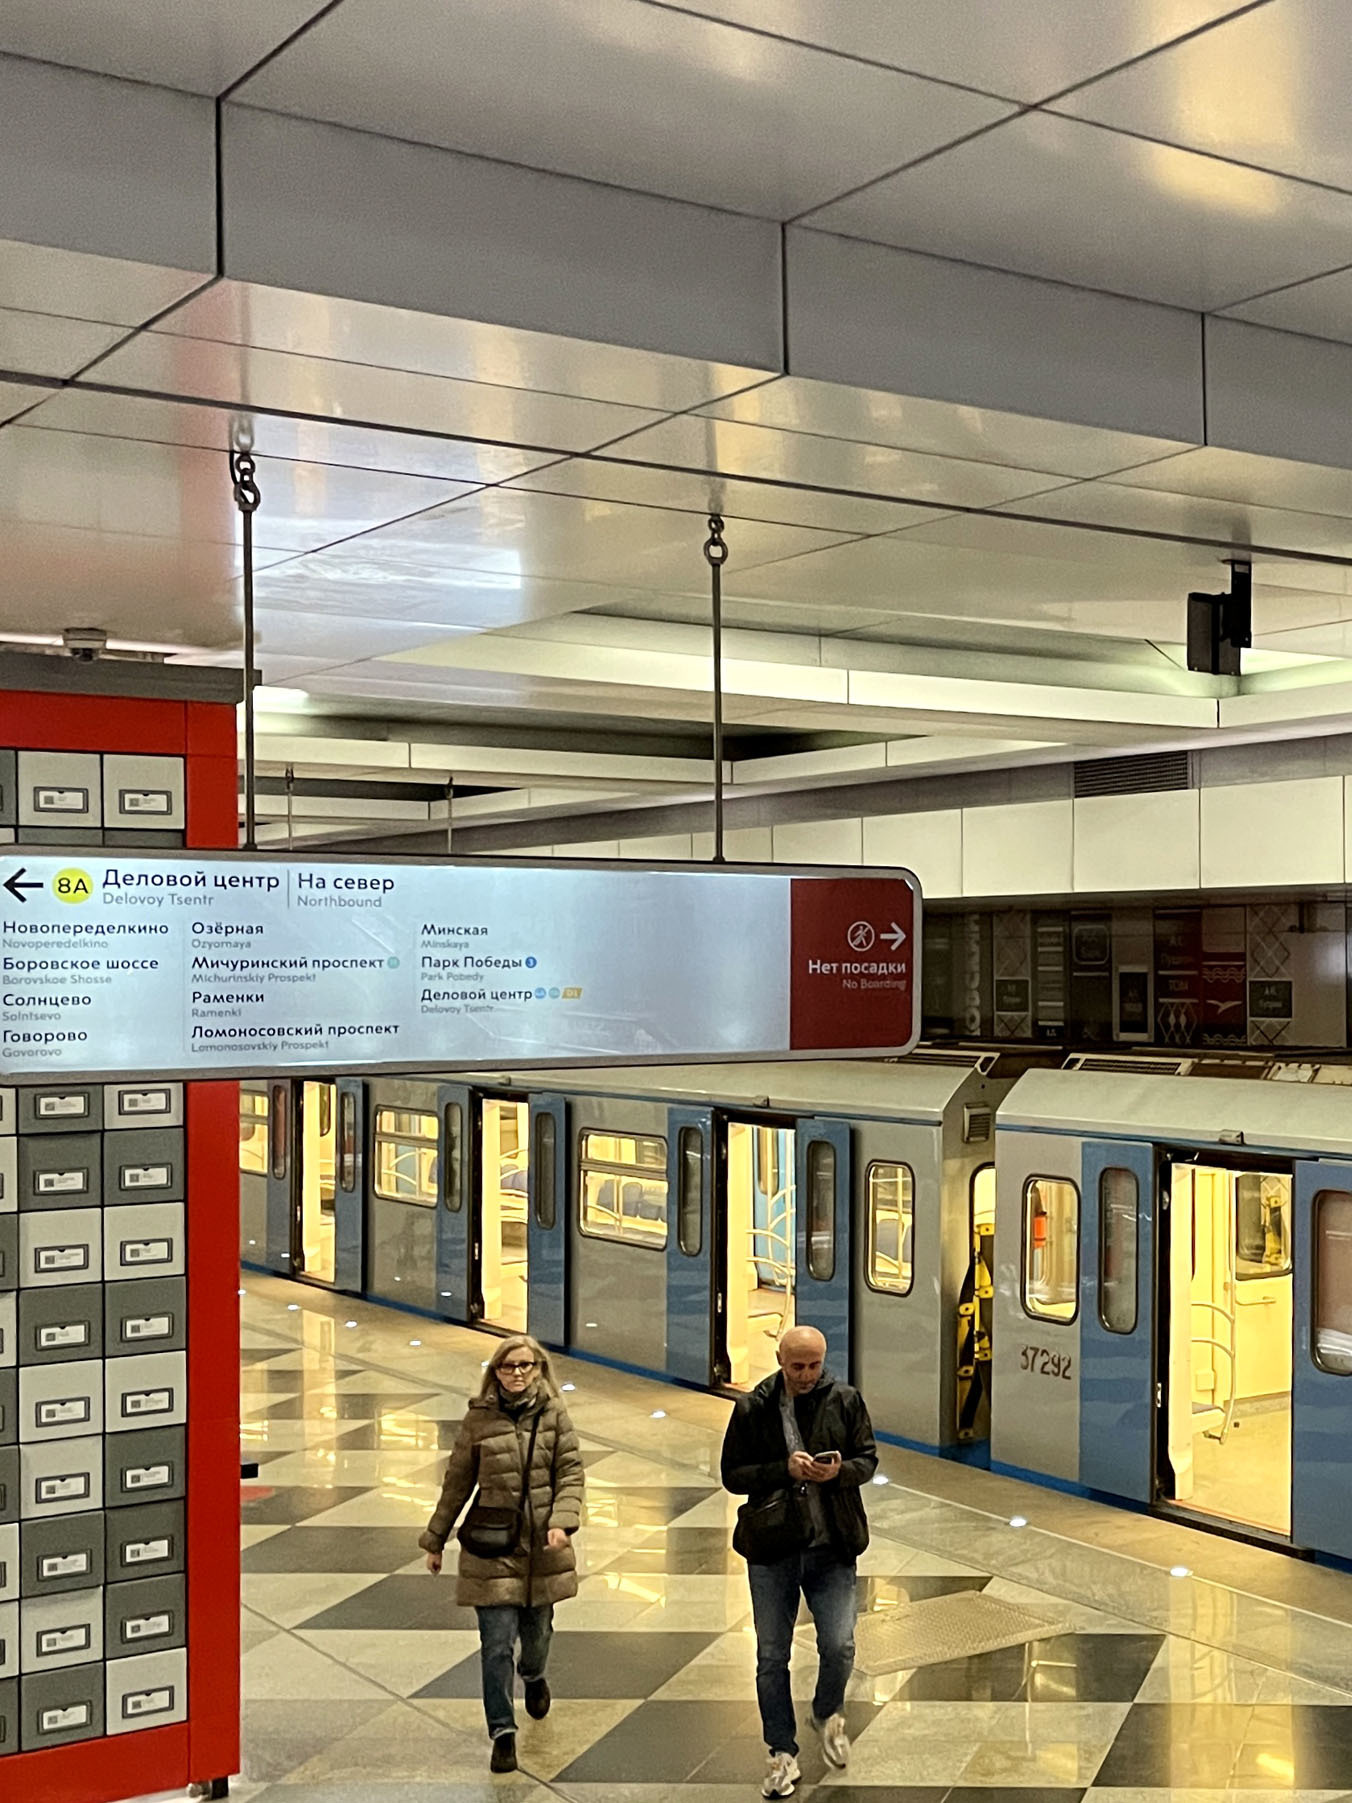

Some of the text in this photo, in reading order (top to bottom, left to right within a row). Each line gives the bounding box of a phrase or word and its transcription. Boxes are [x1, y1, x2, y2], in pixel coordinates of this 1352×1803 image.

[102, 868, 279, 892] Деловой центр
[298, 873, 395, 893] На север
[102, 892, 214, 907] Delovoy Tsentr
[297, 895, 382, 908] Northbound
[3, 921, 169, 937] Новопеределкино
[191, 921, 264, 937] Озёрная
[421, 924, 489, 936] Минская
[2, 938, 109, 951] Novoperedelkino
[421, 939, 469, 950] Minskaya
[3, 957, 159, 972] Боровское шоссе
[191, 956, 385, 972] Мичуринский проспект
[421, 956, 460, 970] Парк
[464, 956, 522, 969] Победы
[808, 959, 906, 976] Нет посадки
[2, 974, 112, 985] Borovskoe Shosse
[191, 972, 316, 985] Michurinskiy Prospekt
[421, 972, 484, 983] Park Pobedy
[842, 979, 858, 989] No
[3, 993, 92, 1007] Солнцево
[192, 991, 265, 1004] Раменки
[421, 988, 533, 1006] Деловой центр
[191, 1008, 242, 1018] Ramenki
[421, 1004, 461, 1014] Delovoy
[2, 1011, 62, 1022] Solntsevo
[3, 1030, 88, 1044] Говорово
[191, 1024, 400, 1039] Ломоносовский проспект
[2, 1047, 63, 1058] Govorovo
[191, 1040, 329, 1053] Lomonosovskiy Prospekt
[1020, 1345, 1072, 1381] 37292
